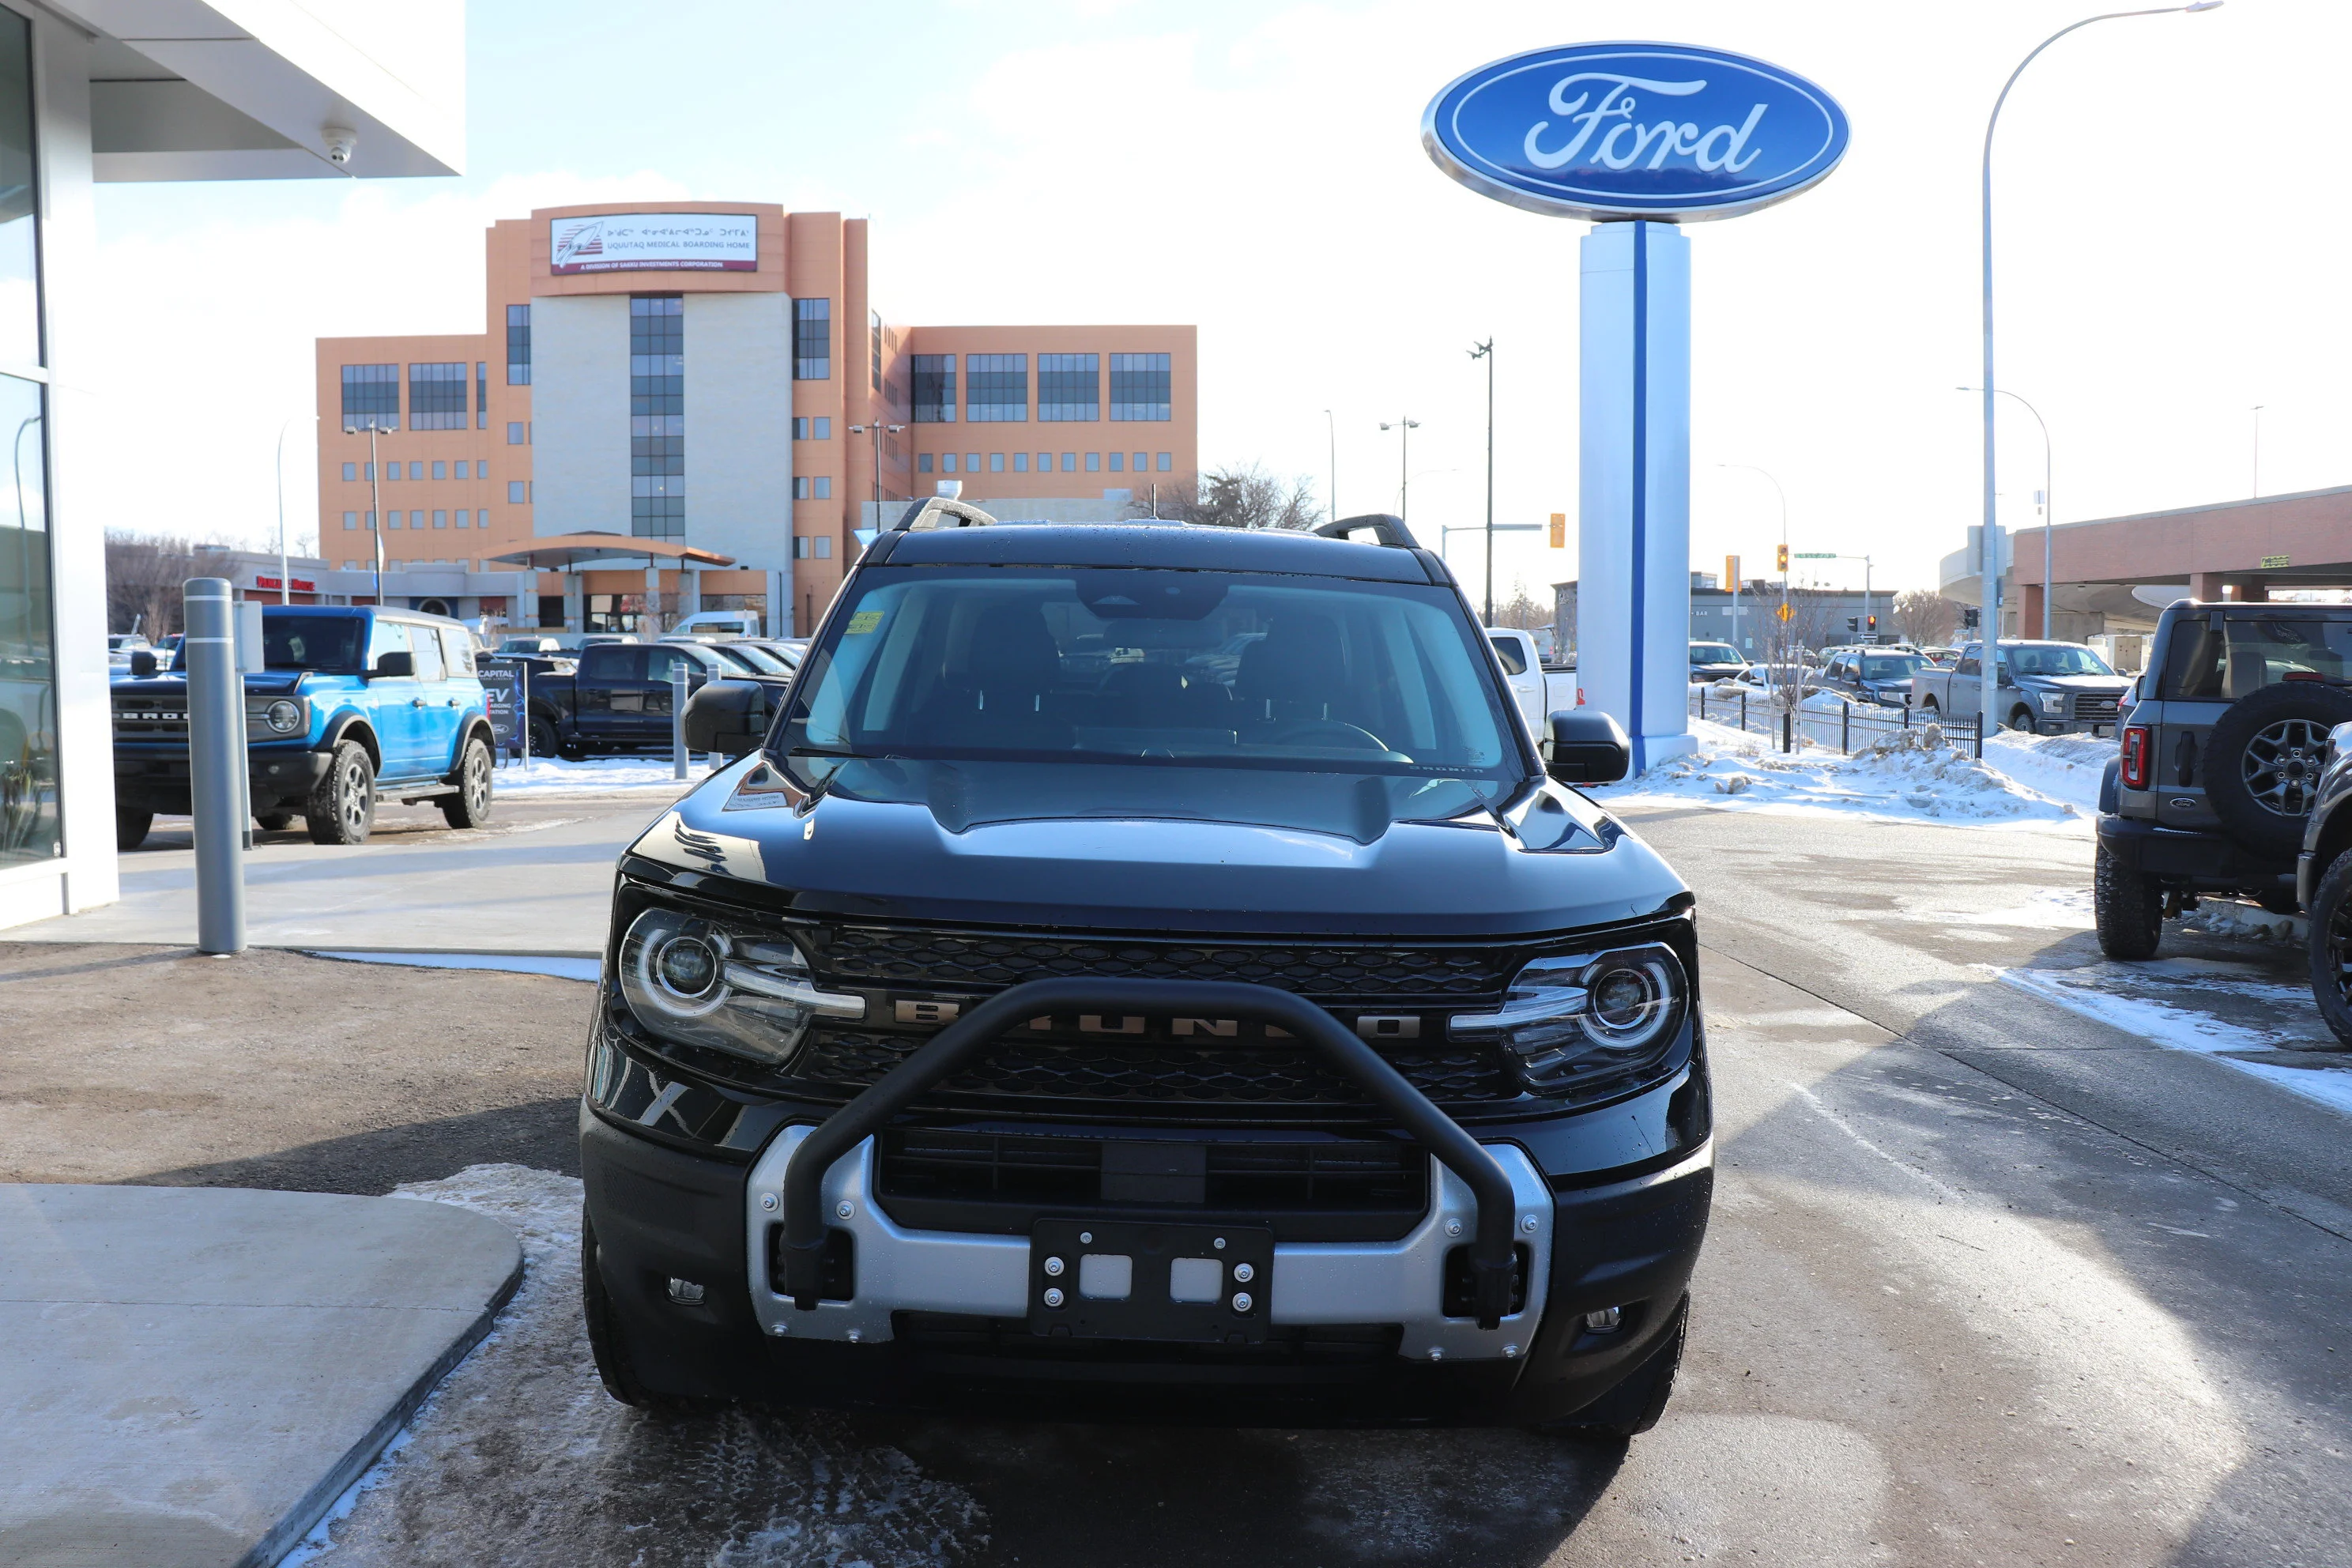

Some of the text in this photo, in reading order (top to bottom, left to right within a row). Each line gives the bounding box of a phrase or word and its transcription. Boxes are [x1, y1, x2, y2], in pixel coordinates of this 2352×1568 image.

[1524, 72, 1769, 174] Ford
[607, 241, 645, 250] UQUUTAQ
[485, 688, 510, 702] EV
